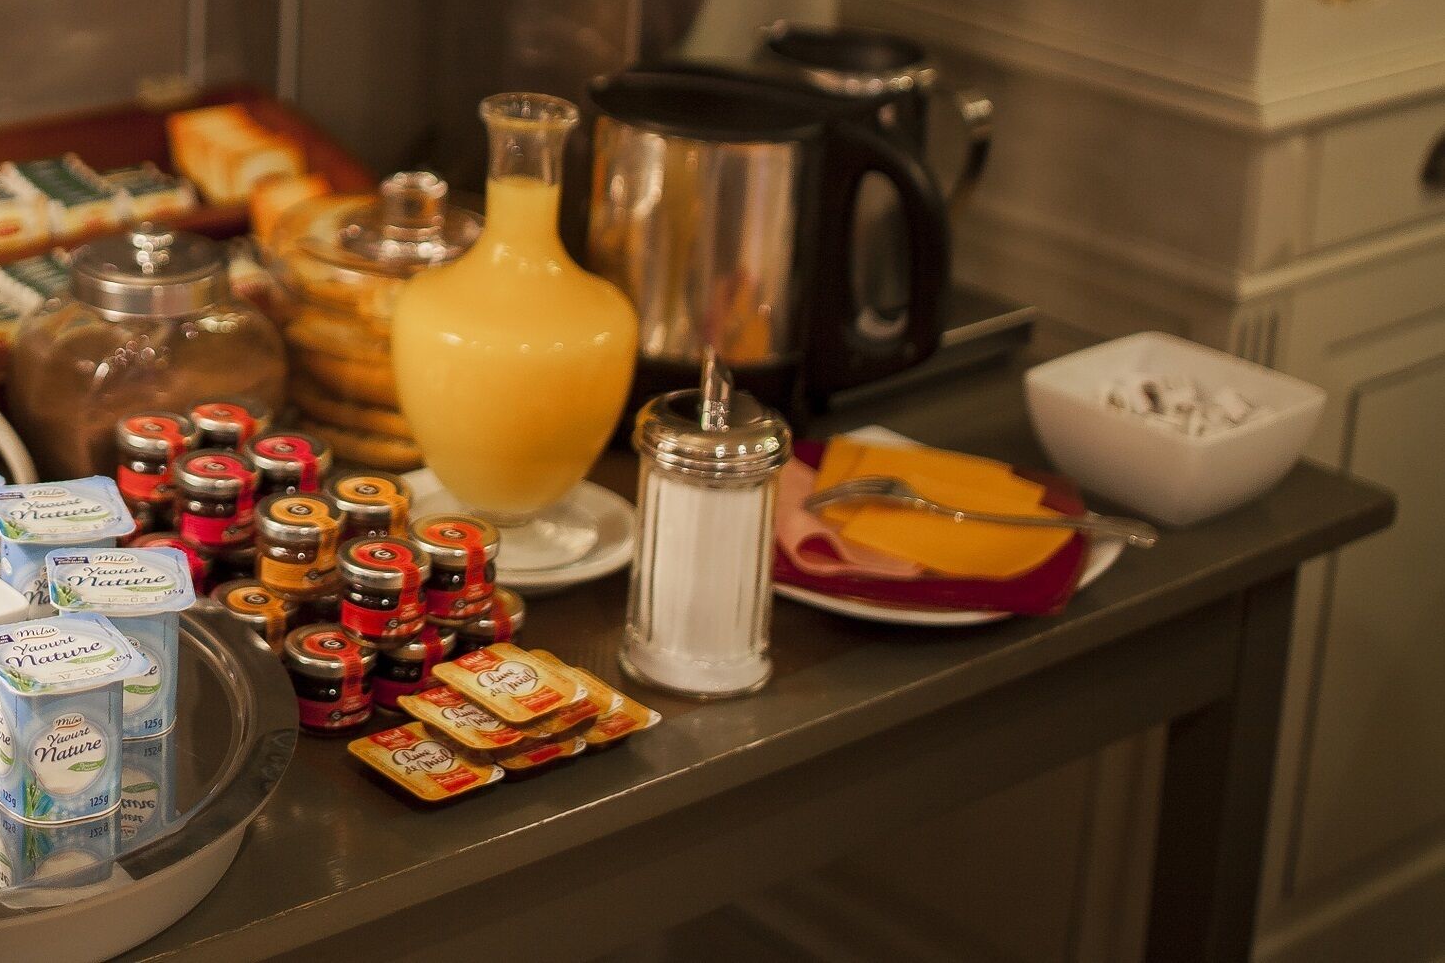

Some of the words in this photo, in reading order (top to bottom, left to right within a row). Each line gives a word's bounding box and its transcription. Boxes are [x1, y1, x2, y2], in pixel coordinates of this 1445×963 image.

[22, 497, 83, 510] Yaourt
[10, 505, 102, 520] Nature
[95, 552, 134, 563] Milsa
[83, 564, 148, 577] Yaourt
[66, 574, 167, 587] Nature
[16, 626, 56, 638] Milsa
[13, 635, 76, 656] Yaourt
[5, 642, 103, 669] Nature
[109, 652, 134, 664] 125g
[490, 687, 503, 697] de
[55, 715, 83, 727] Milsa
[143, 718, 163, 730] 125g
[46, 726, 91, 748] Yaourt
[34, 738, 102, 763] Nature
[405, 765, 420, 775] de
[2, 789, 17, 808] 125g
[89, 794, 109, 808] 125g
